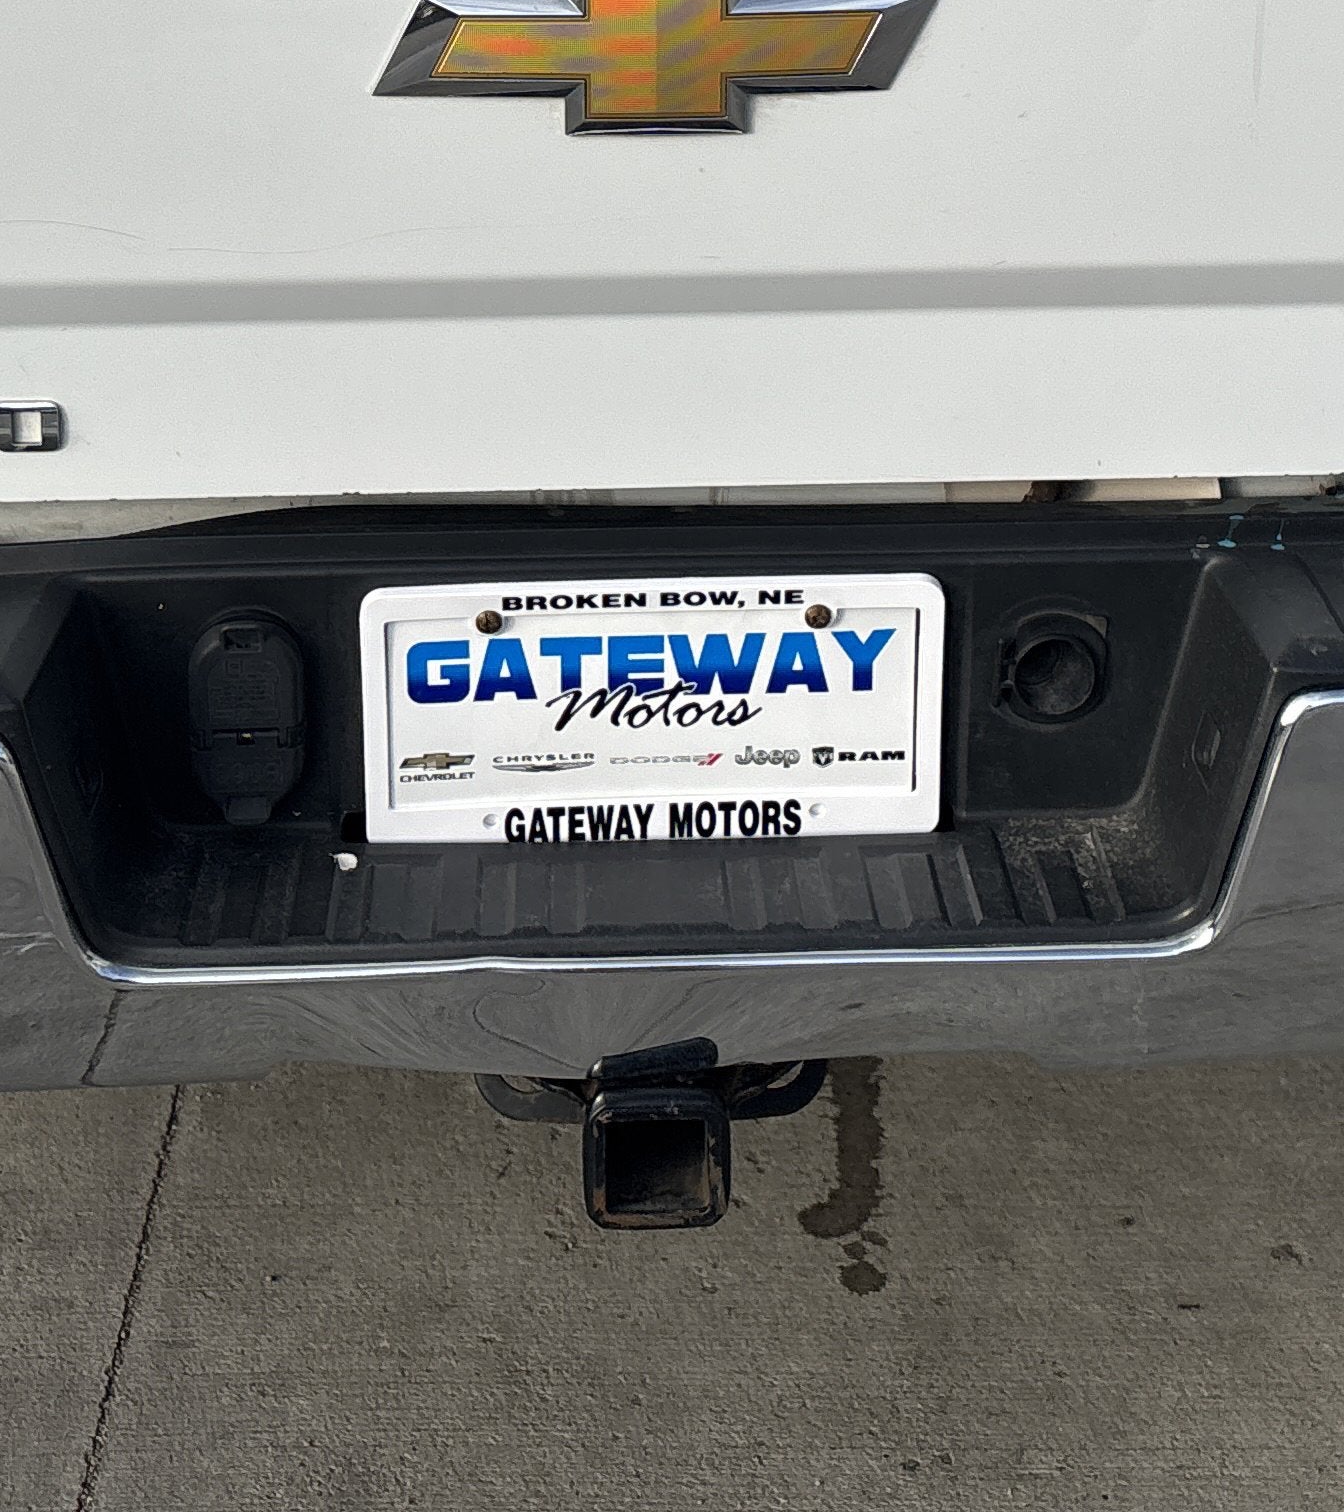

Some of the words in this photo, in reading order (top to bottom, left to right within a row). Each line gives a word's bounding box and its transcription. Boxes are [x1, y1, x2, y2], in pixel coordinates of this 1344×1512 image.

[501, 592, 647, 611] BROKEN
[660, 590, 745, 608] BOW,
[758, 589, 805, 605] NE
[406, 628, 897, 704] GATEWAY
[545, 681, 762, 731] Motors
[492, 752, 595, 764] CHRYSLER
[609, 754, 710, 765] DODGE
[734, 745, 801, 768] Jeep
[837, 750, 906, 762] RAM
[399, 770, 476, 784] CHEVROLET
[504, 804, 655, 844] GATEWAY
[669, 798, 802, 838] MOTORS
